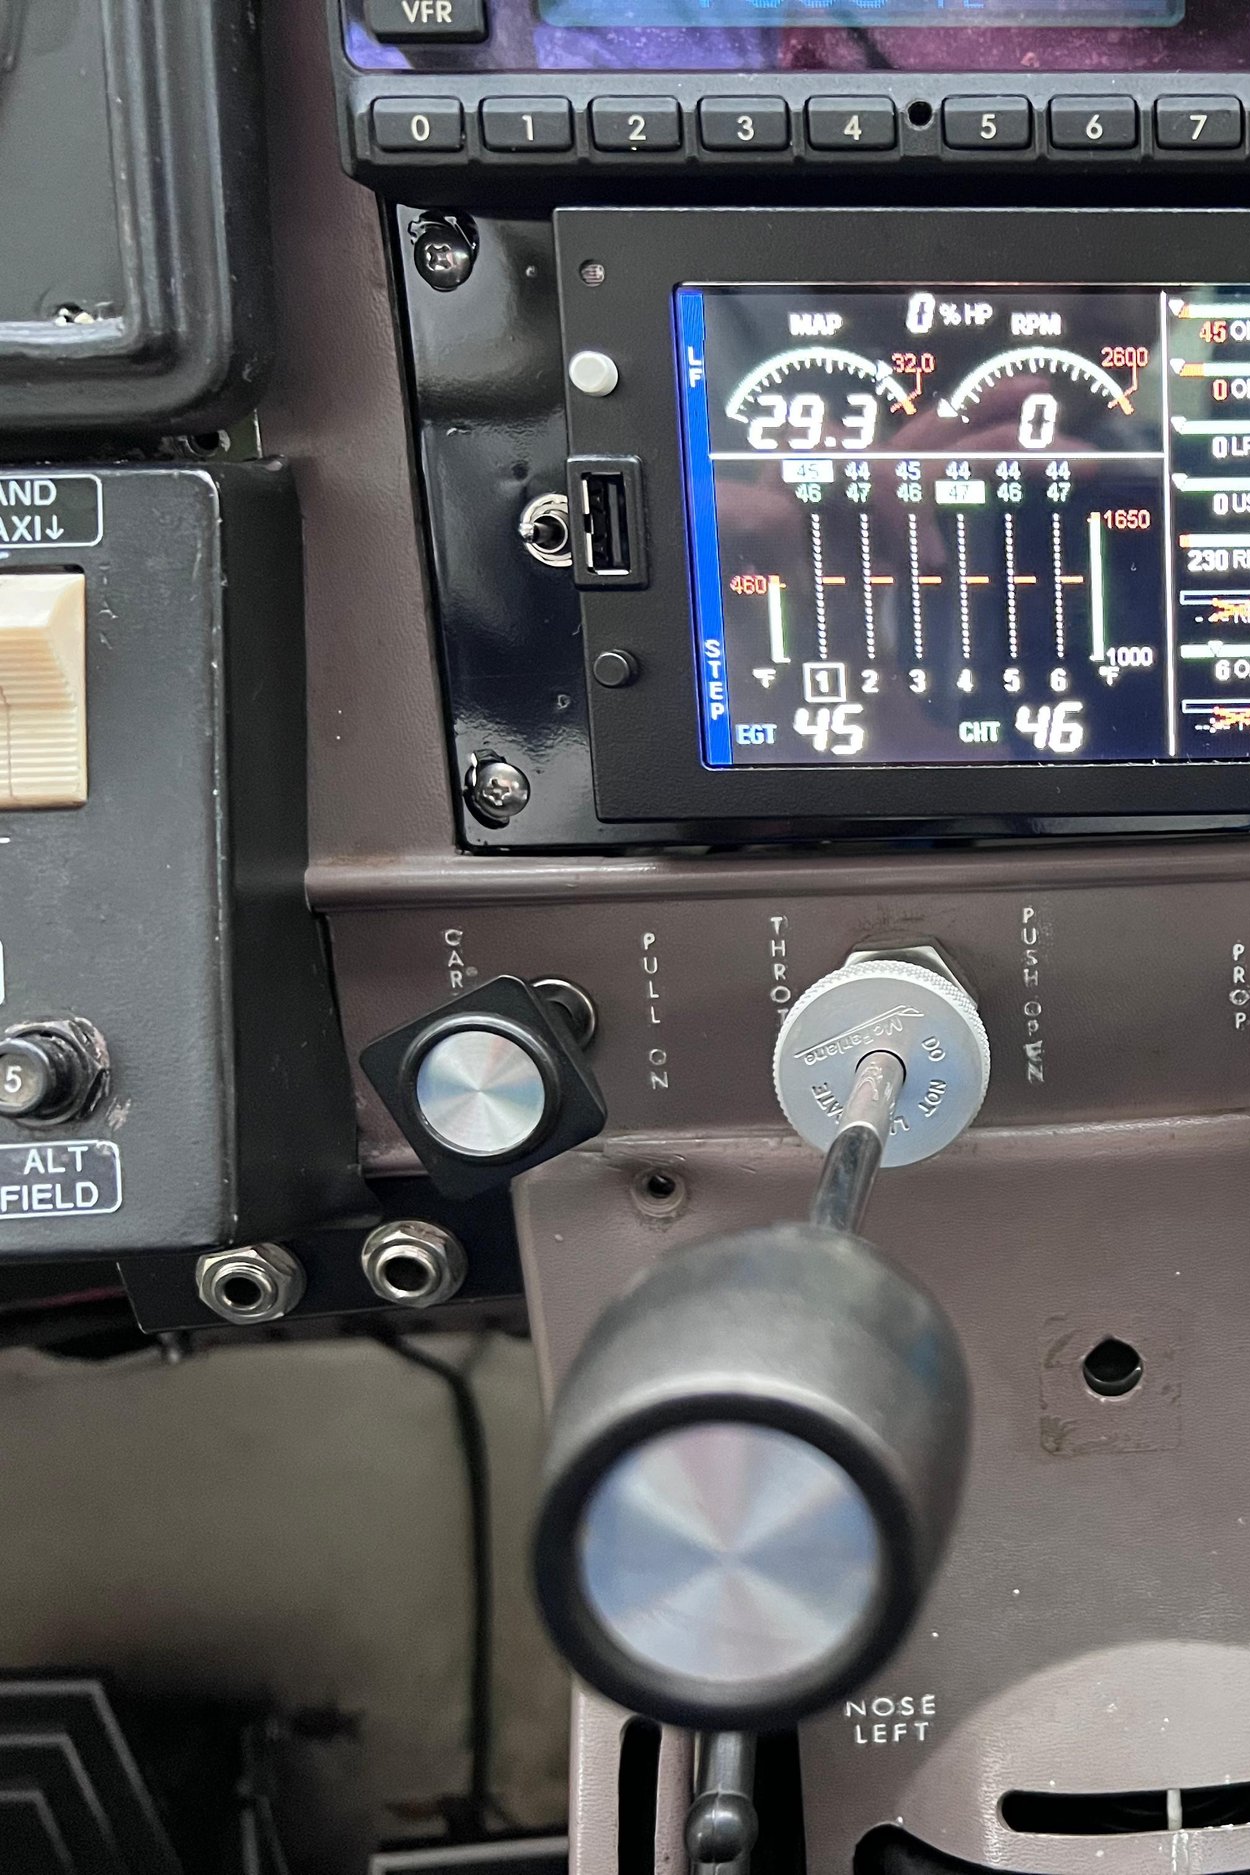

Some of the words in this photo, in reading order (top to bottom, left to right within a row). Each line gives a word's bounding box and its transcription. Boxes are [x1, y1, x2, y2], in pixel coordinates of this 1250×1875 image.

[402, 0, 452, 24] VFR
[410, 116, 430, 142] 0
[521, 115, 535, 141] 1
[628, 115, 647, 142] 2
[737, 116, 755, 142] 3
[843, 116, 862, 141] 4
[980, 113, 997, 140] 5
[1085, 113, 1104, 140] 6
[1189, 114, 1208, 140] 7
[790, 313, 842, 337] MAP
[905, 292, 935, 334] 0
[1011, 312, 1062, 336] RPM
[1199, 321, 1227, 343] 45
[891, 352, 935, 374] 32.0
[1101, 346, 1149, 368] 2600
[1212, 379, 1229, 401] 0
[747, 394, 877, 450] 29.3
[1019, 394, 1057, 449] 0
[1211, 436, 1228, 459] 0
[844, 461, 871, 481] 44
[894, 461, 921, 481] 45
[945, 461, 971, 481] 44
[995, 461, 1021, 481] 44
[1045, 461, 1071, 481] 44
[795, 483, 822, 504] 46
[845, 483, 872, 503] 47
[896, 482, 923, 503] 46
[996, 482, 1023, 503] 46
[1046, 482, 1072, 503] 47
[1213, 493, 1230, 515] 0
[1103, 510, 1150, 529] 1650
[1186, 549, 1229, 571] 230
[729, 575, 769, 596] 460
[1106, 646, 1153, 667] 1000
[703, 639, 726, 721] STEP
[814, 670, 830, 694] 1
[861, 669, 880, 694] 2
[908, 669, 927, 693] 3
[956, 669, 974, 693] 4
[1003, 669, 1021, 693] 5
[1049, 668, 1067, 692] 6
[735, 724, 777, 745] EGT
[793, 703, 865, 755] 45
[959, 721, 1001, 743] CHT
[1015, 701, 1084, 753] 46
[1022, 906, 1040, 987] PUSH
[444, 928, 465, 997] CAR
[642, 931, 661, 1025] PULL
[1229, 942, 1250, 1030] PROP
[920, 1036, 946, 1063] DO
[3, 1065, 22, 1094] 5
[649, 1048, 669, 1090] ON
[917, 1079, 948, 1118] NOT
[23, 1146, 89, 1175] ALT
[0, 1181, 100, 1213] FIELD
[845, 1694, 937, 1719] NOSE
[855, 1721, 930, 1745] LEFT
